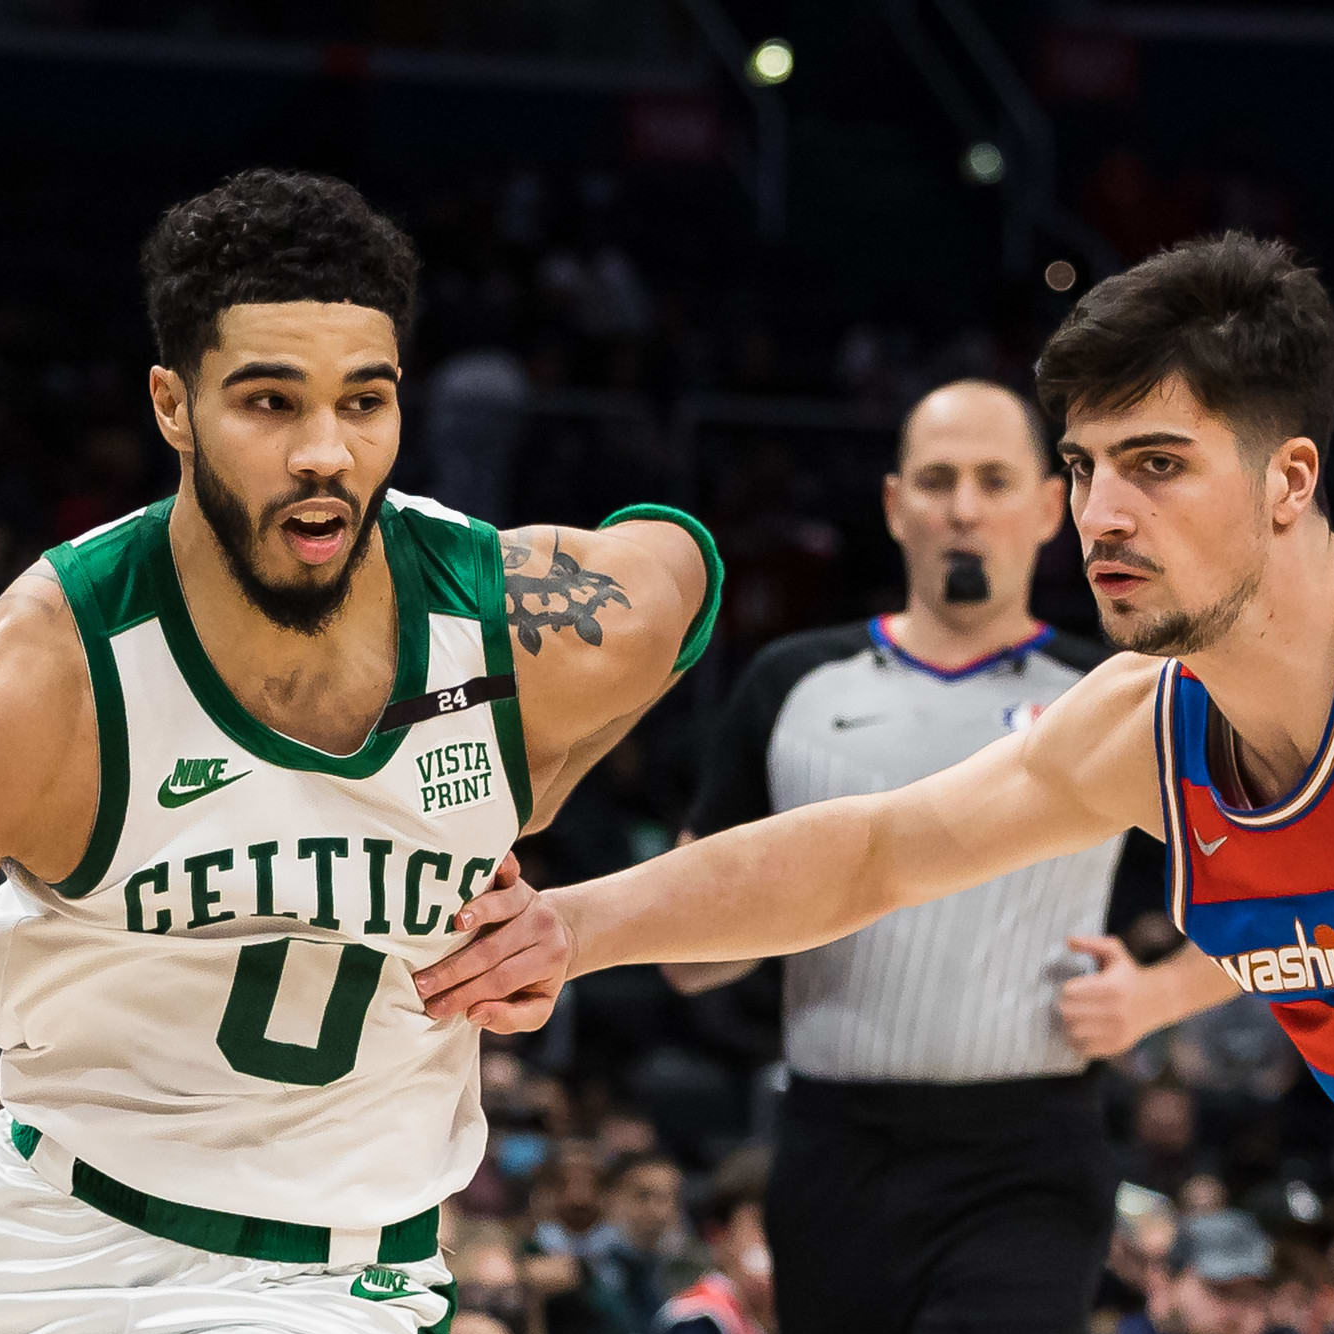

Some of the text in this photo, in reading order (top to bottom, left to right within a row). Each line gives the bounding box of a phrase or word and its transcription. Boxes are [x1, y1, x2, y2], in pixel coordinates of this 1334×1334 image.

[436, 687, 468, 713] 24
[170, 758, 229, 788] NIKE
[415, 742, 492, 785] VISTA
[420, 771, 492, 813] PRINT
[123, 836, 496, 936] CELTICS
[215, 936, 389, 1088] 0
[363, 1266, 411, 1293] NIKE
